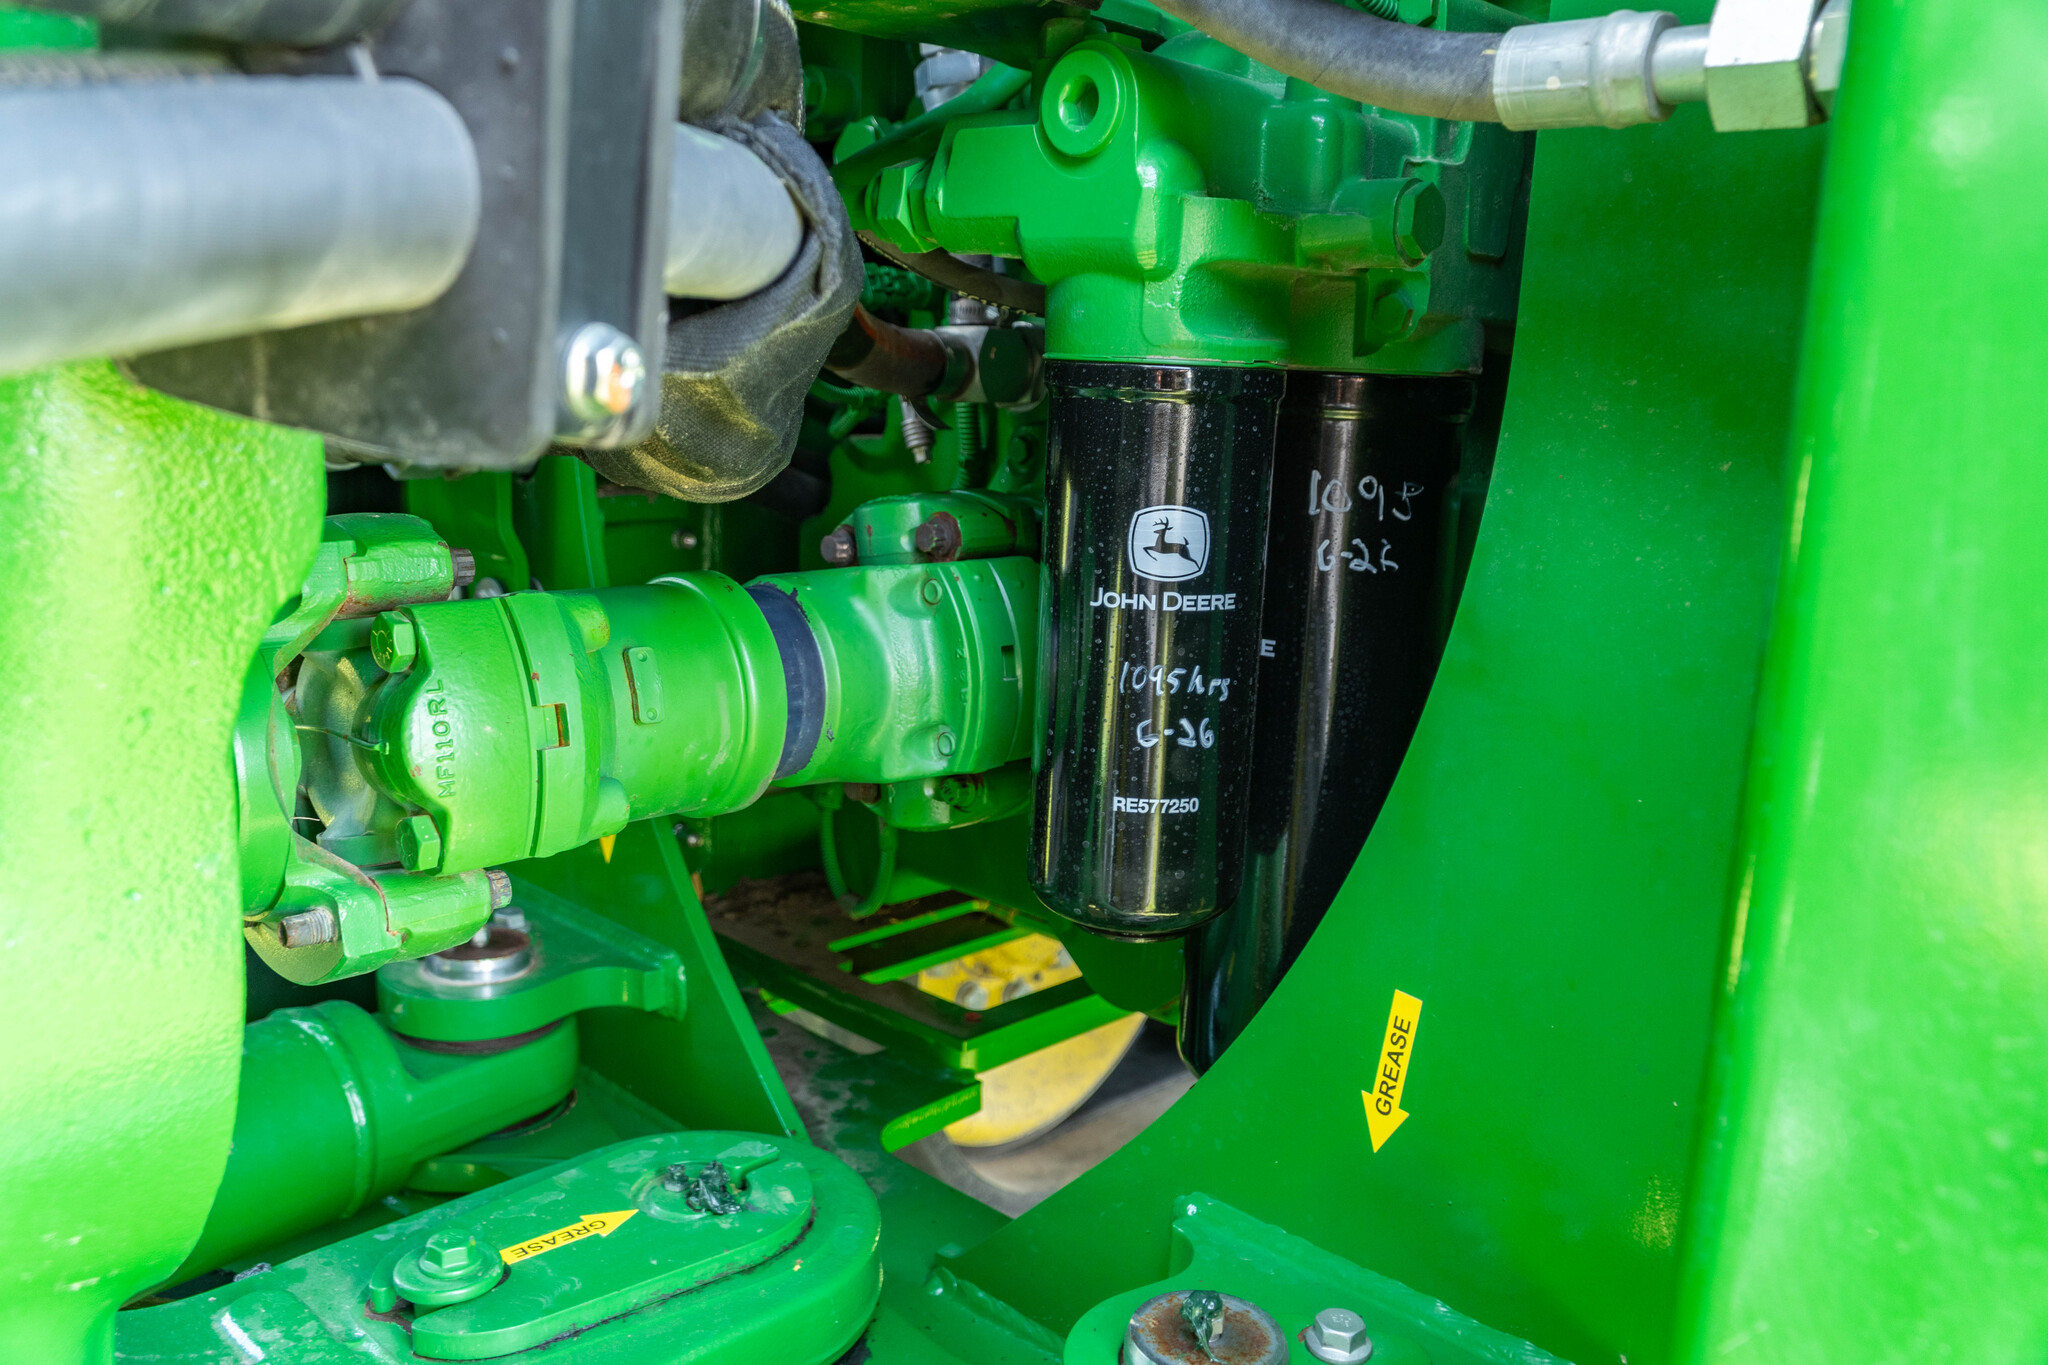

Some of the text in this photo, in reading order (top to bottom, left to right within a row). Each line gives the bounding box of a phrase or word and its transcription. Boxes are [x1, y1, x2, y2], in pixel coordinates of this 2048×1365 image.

[1089, 587, 1237, 612] JOHN DEERE
[1136, 717, 1215, 749] 6-26
[1112, 796, 1200, 814] RE577250
[1375, 1015, 1412, 1116] GREASE
[510, 1219, 606, 1259] GREASE
